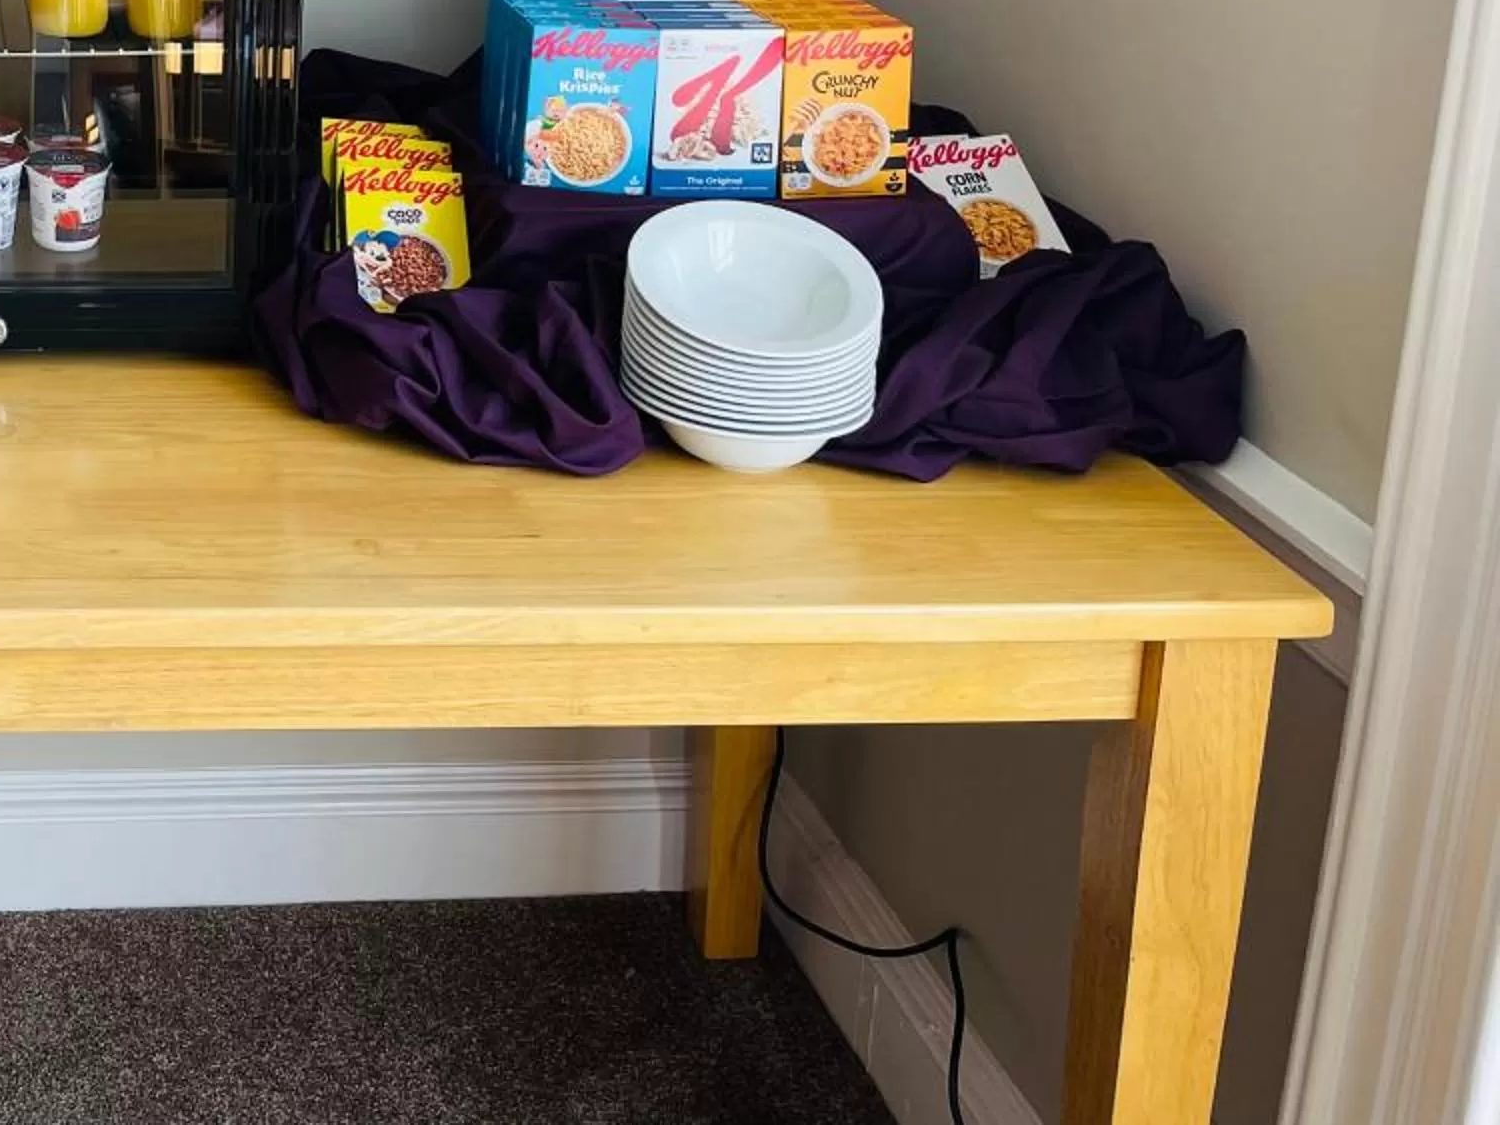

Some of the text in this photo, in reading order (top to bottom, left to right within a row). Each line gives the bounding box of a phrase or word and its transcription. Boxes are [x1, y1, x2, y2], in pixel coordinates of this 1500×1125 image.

[784, 30, 913, 70] Kellogg's
[812, 70, 879, 94] CRUNCHY
[833, 87, 863, 98] NUT
[336, 135, 454, 172] Kellogg's
[344, 167, 463, 205] Kellogg's
[946, 172, 987, 186] CORN
